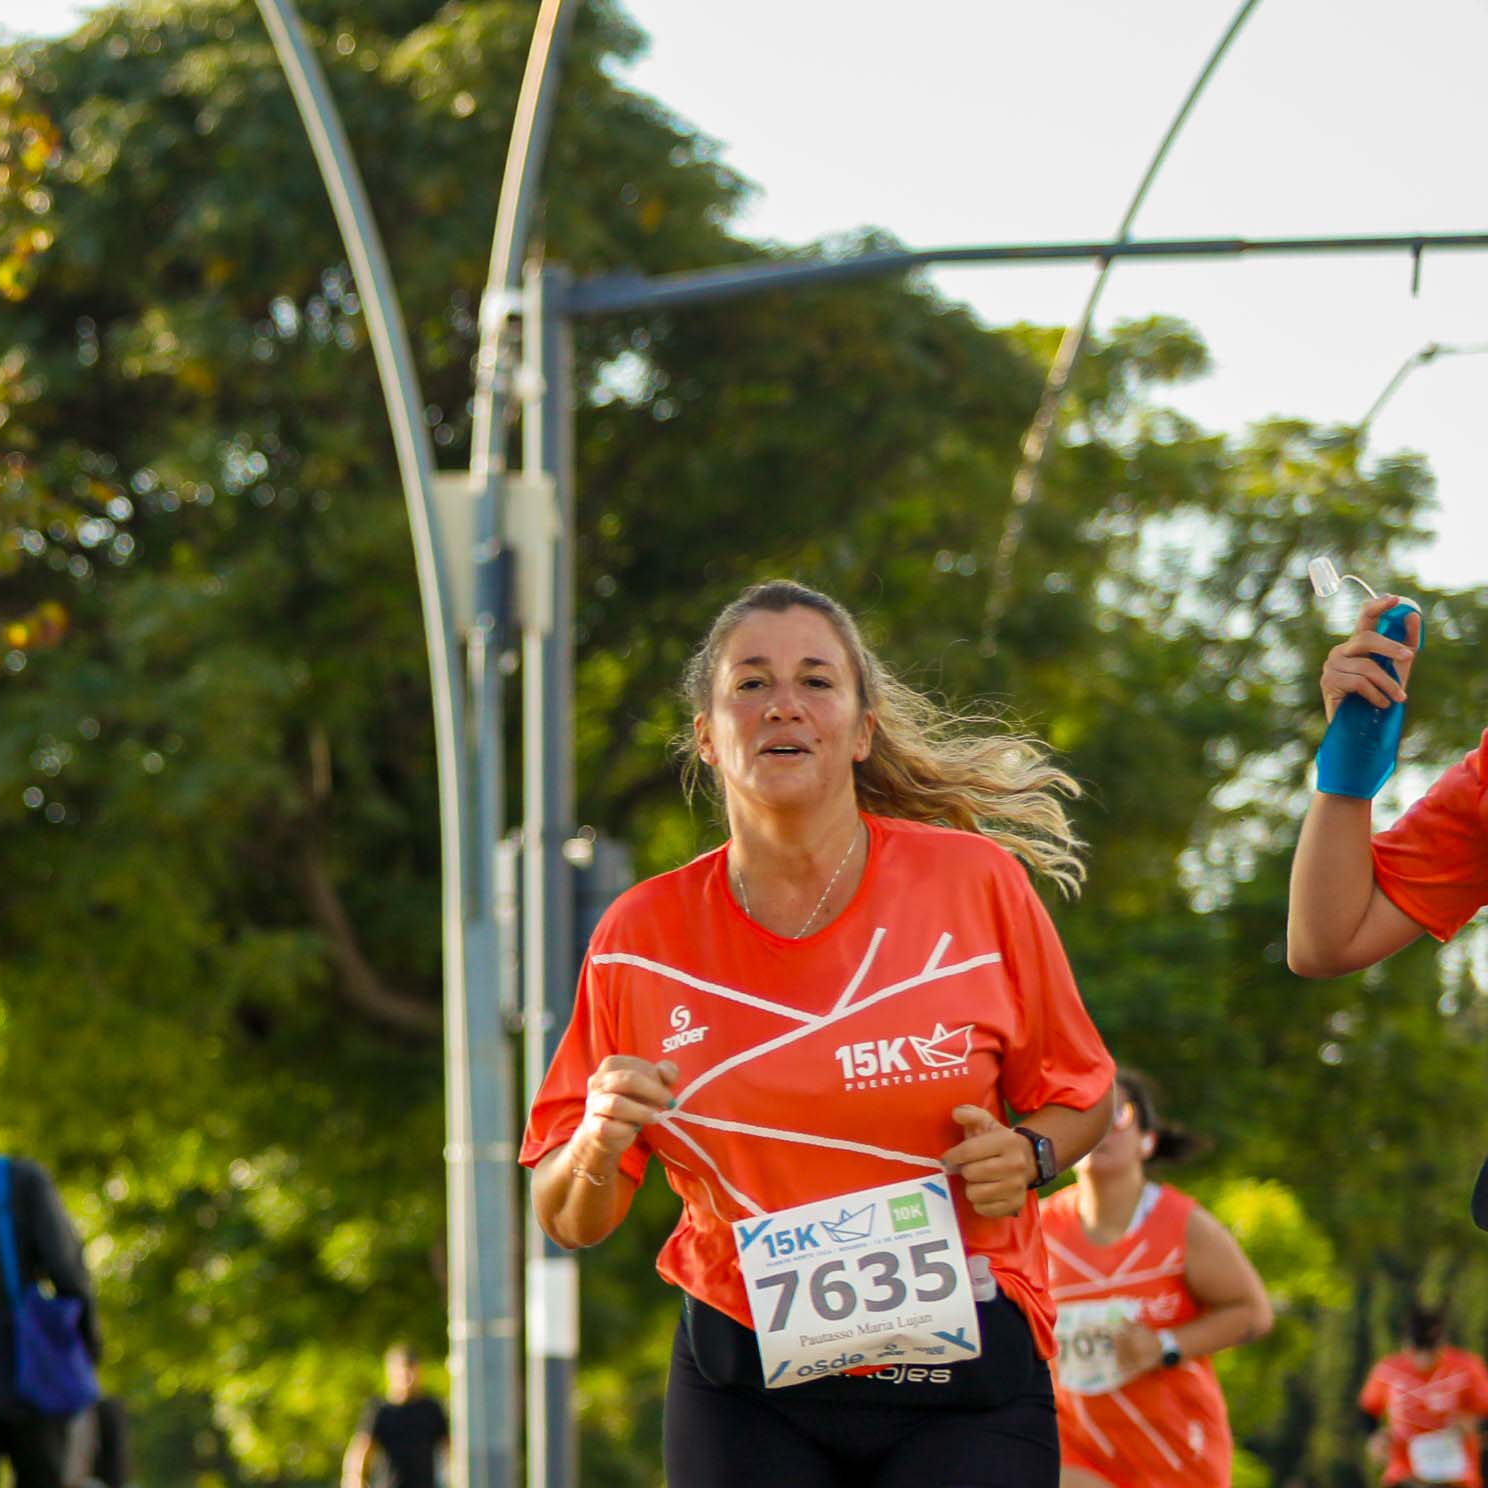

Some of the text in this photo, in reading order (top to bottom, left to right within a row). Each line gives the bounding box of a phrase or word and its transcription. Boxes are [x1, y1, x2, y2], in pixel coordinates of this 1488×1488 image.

[835, 1037, 911, 1079] 15K
[845, 1066, 969, 1091] PUERTO NORTE
[893, 1205, 922, 1222] 10K
[762, 1222, 820, 1258] 15K
[755, 1239, 957, 1333] 7635
[800, 1330, 853, 1348] Pautasso
[797, 1352, 864, 1377] osde
